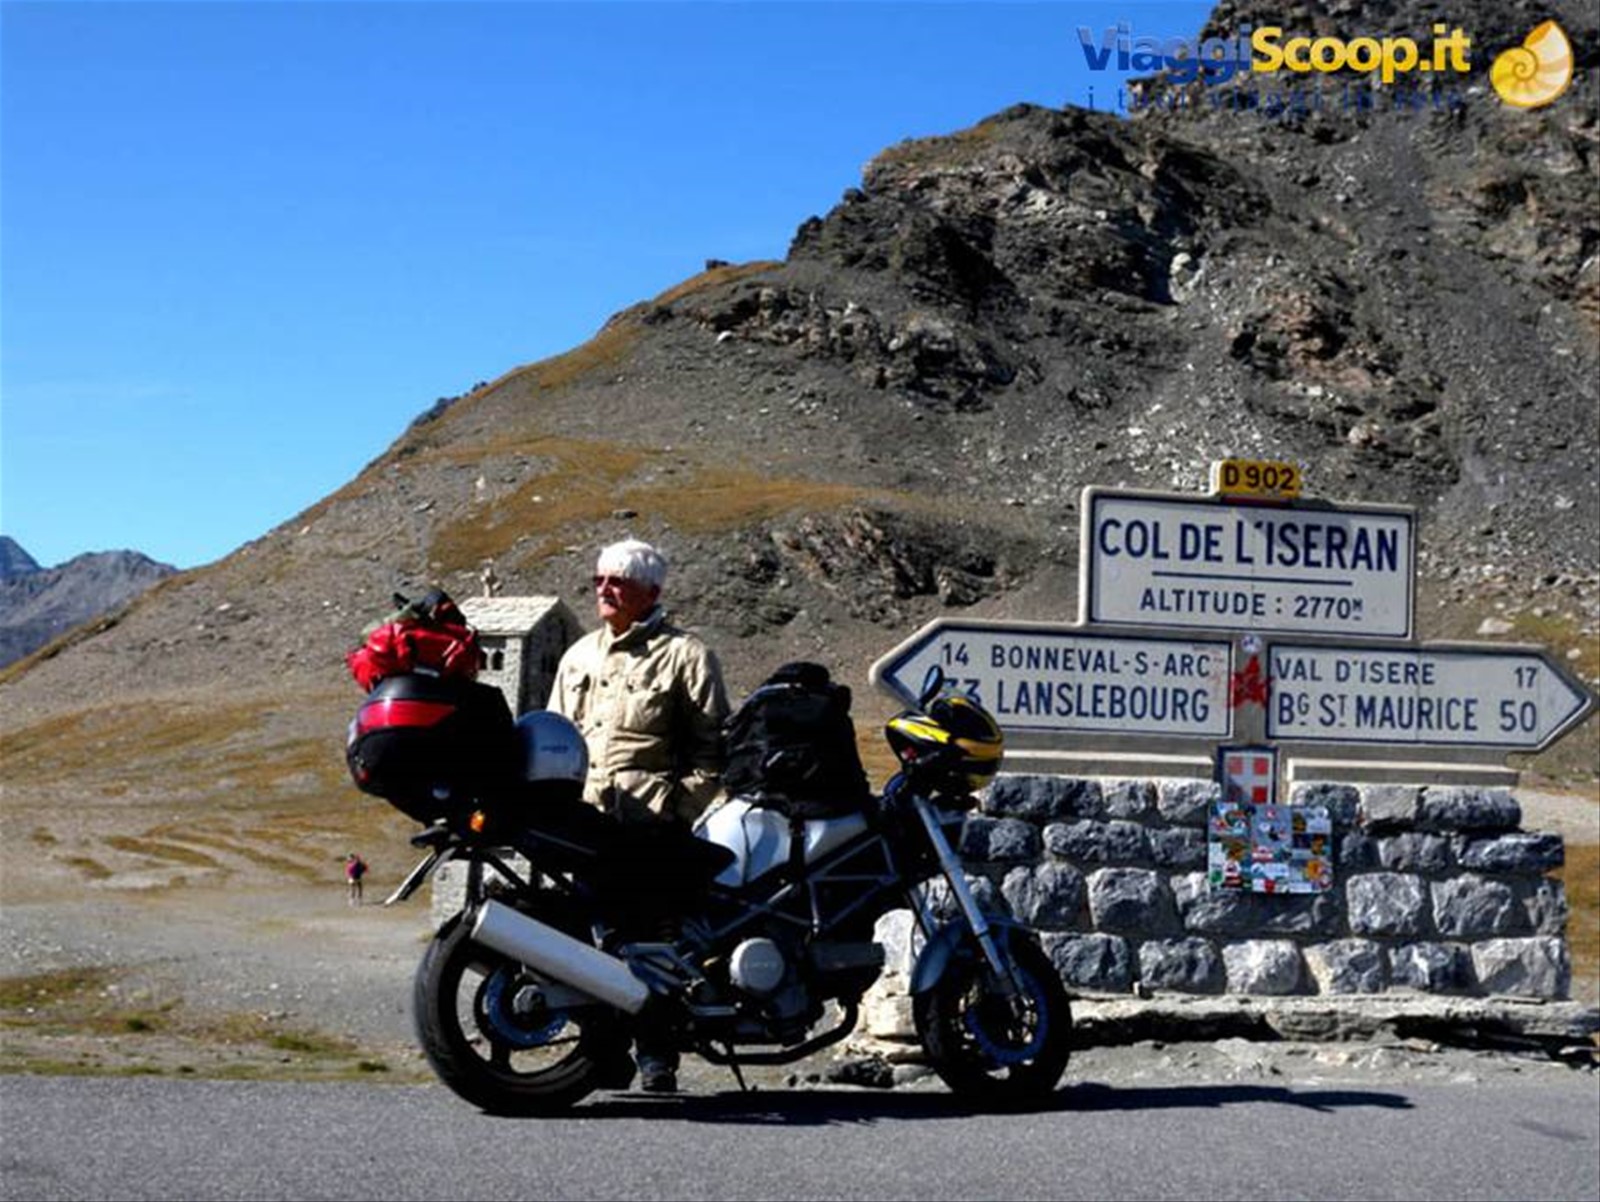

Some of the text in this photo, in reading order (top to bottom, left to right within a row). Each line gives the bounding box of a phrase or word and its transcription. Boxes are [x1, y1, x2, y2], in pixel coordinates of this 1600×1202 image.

[1224, 464, 1295, 490] D 902
[1100, 518, 1398, 571] COL DE L'ISERAN
[1141, 588, 1266, 616] ALTITUDE
[942, 642, 969, 666] 14
[1275, 657, 1538, 689] VAL D'ISERE 17
[997, 680, 1209, 723] LANSLEBOURG
[1355, 695, 1479, 732] MAURICE
[1499, 700, 1538, 734] 50
